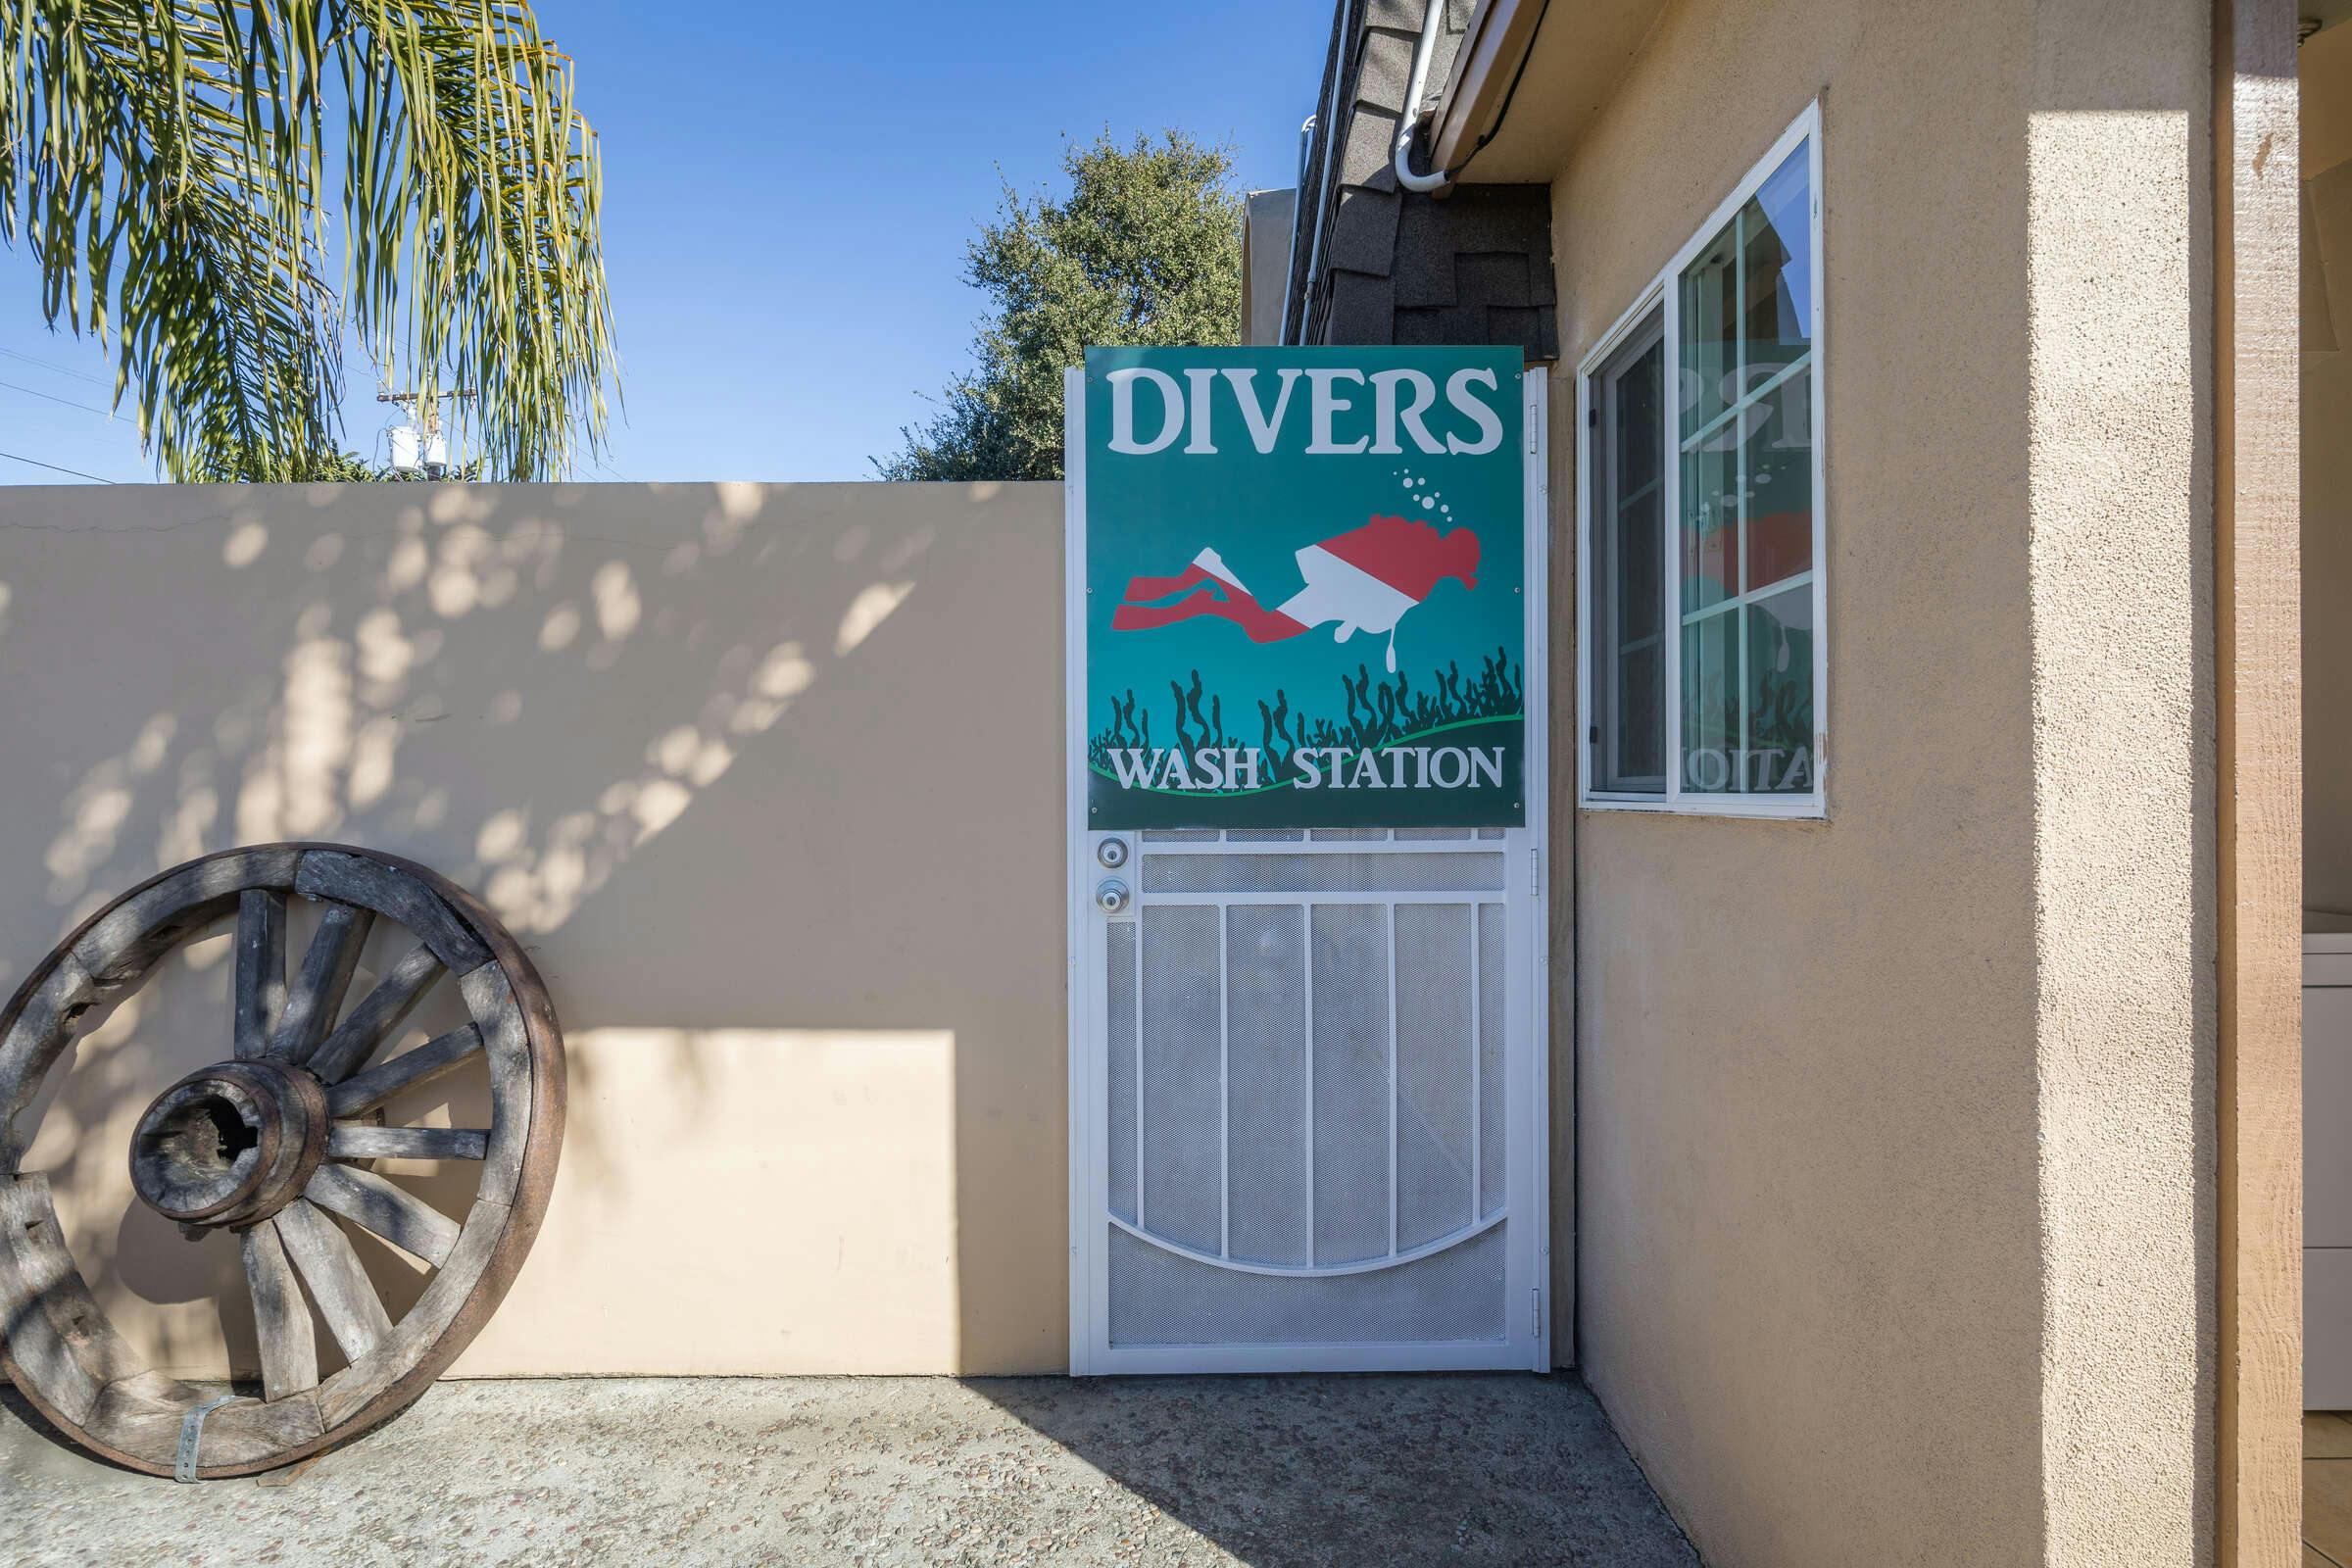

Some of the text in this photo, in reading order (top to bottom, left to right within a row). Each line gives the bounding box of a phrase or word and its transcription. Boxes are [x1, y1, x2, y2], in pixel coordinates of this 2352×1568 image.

[1106, 368, 1503, 455] DIVERS
[1106, 747, 1505, 790] WASH STATION
